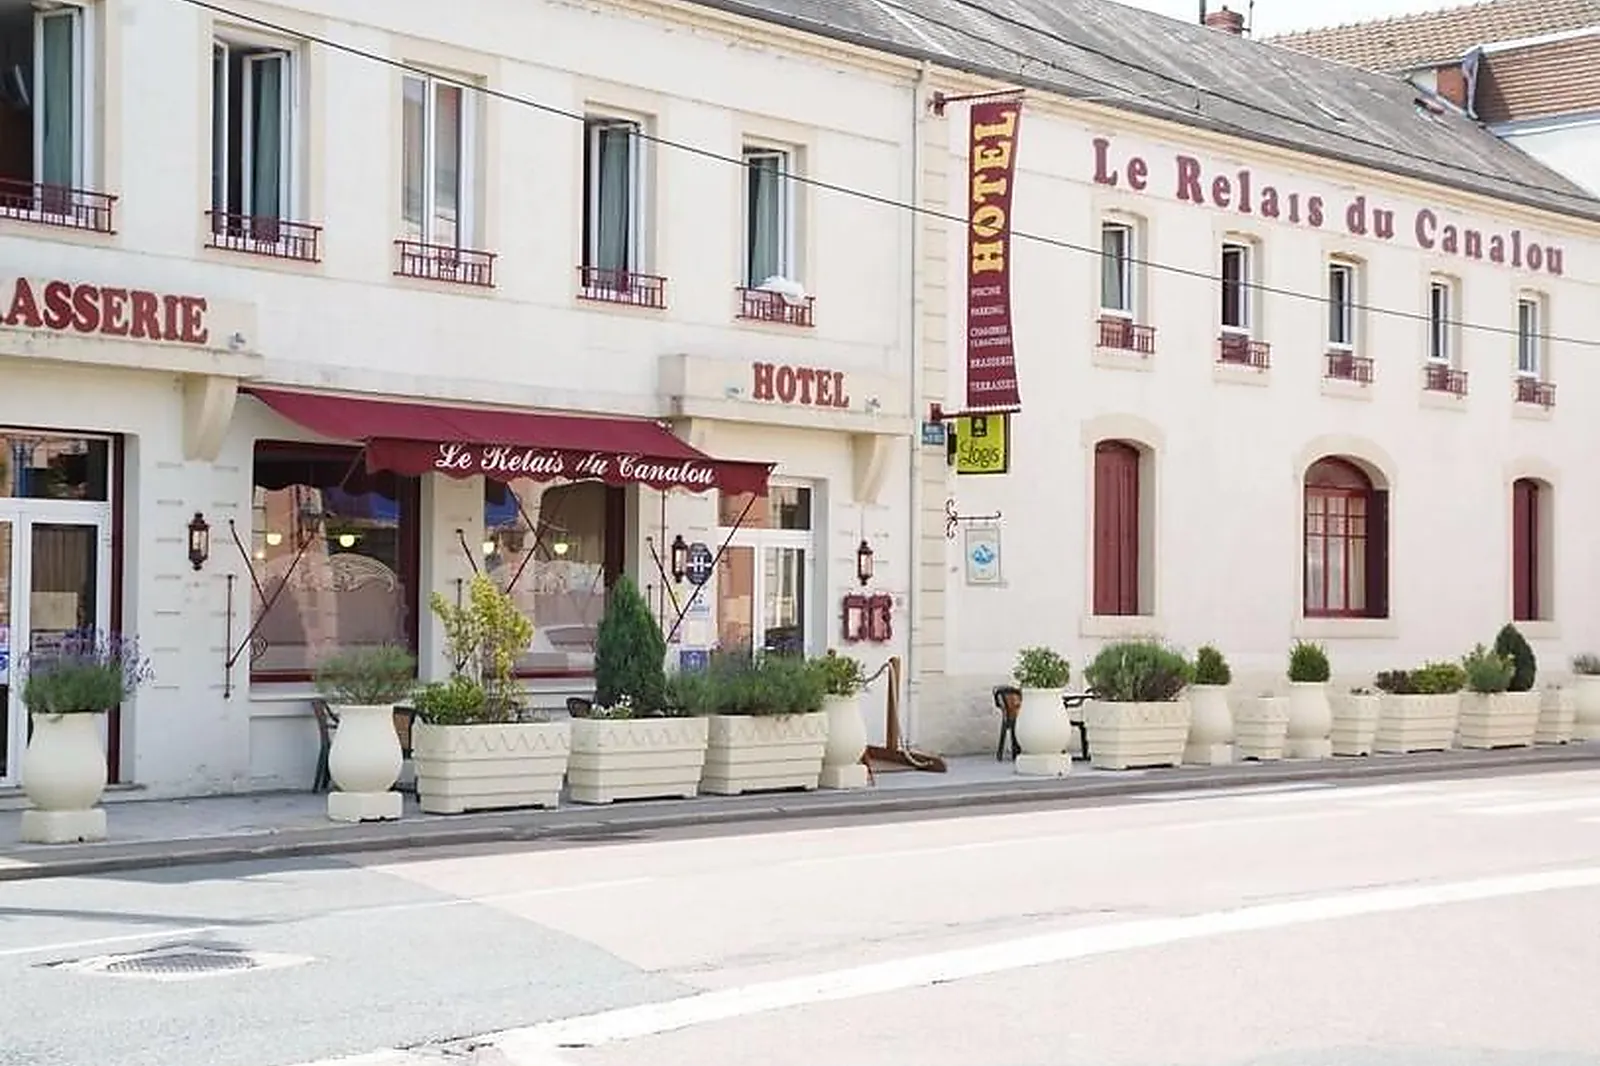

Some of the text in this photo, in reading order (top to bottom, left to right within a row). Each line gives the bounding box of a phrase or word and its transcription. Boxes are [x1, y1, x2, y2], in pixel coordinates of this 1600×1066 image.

[973, 110, 1017, 274] HOTEL
[1093, 138, 1563, 275] Le Relais du Canalou
[0, 277, 208, 344] ASSERIE
[752, 361, 850, 408] HOTEL
[435, 443, 473, 469] Le
[481, 446, 564, 473] Relais
[616, 455, 715, 485] Canalou
[959, 438, 1000, 468] Logis
